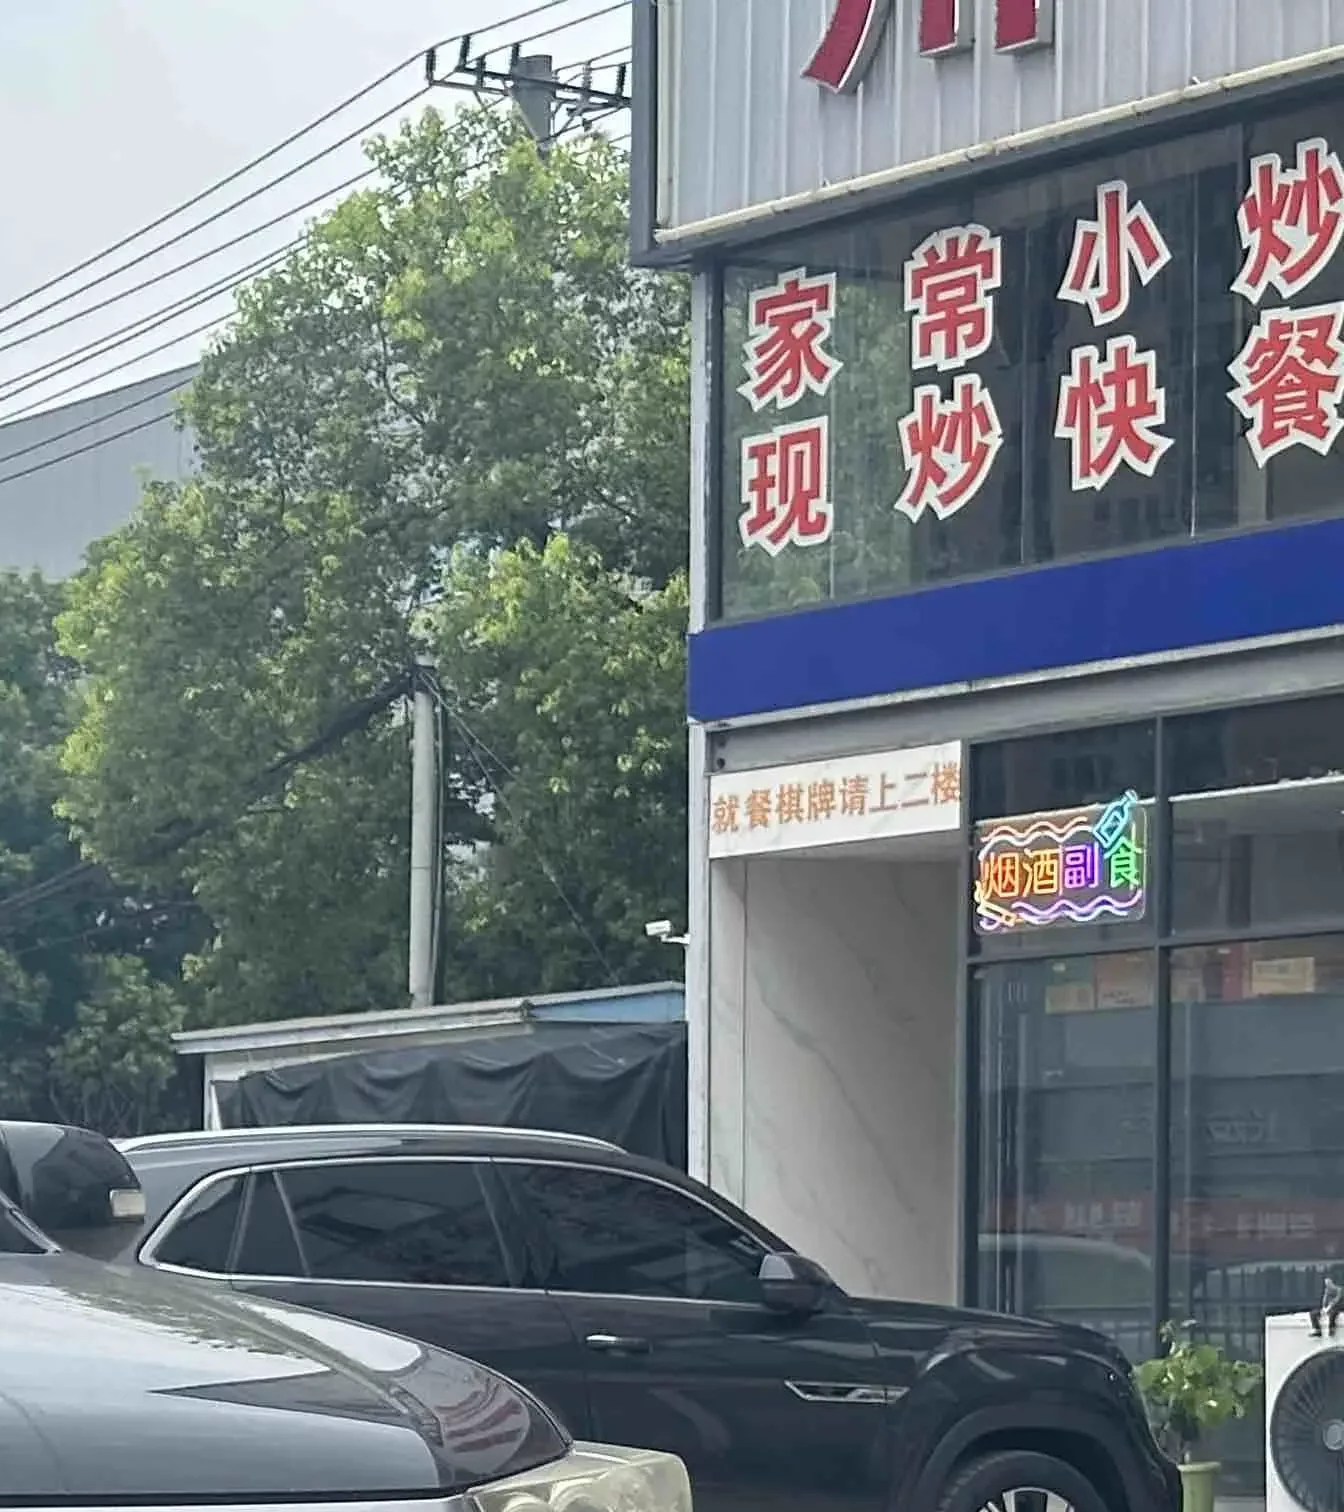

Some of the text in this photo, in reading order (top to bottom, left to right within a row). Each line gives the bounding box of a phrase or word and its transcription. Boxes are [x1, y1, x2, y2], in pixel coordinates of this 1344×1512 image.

[741, 140, 1344, 409] 家常小炒
[740, 303, 1344, 551] 现炒快餐
[712, 759, 960, 834] 就餐棋牌请上二楼
[982, 836, 1142, 899] 烟酒副食
